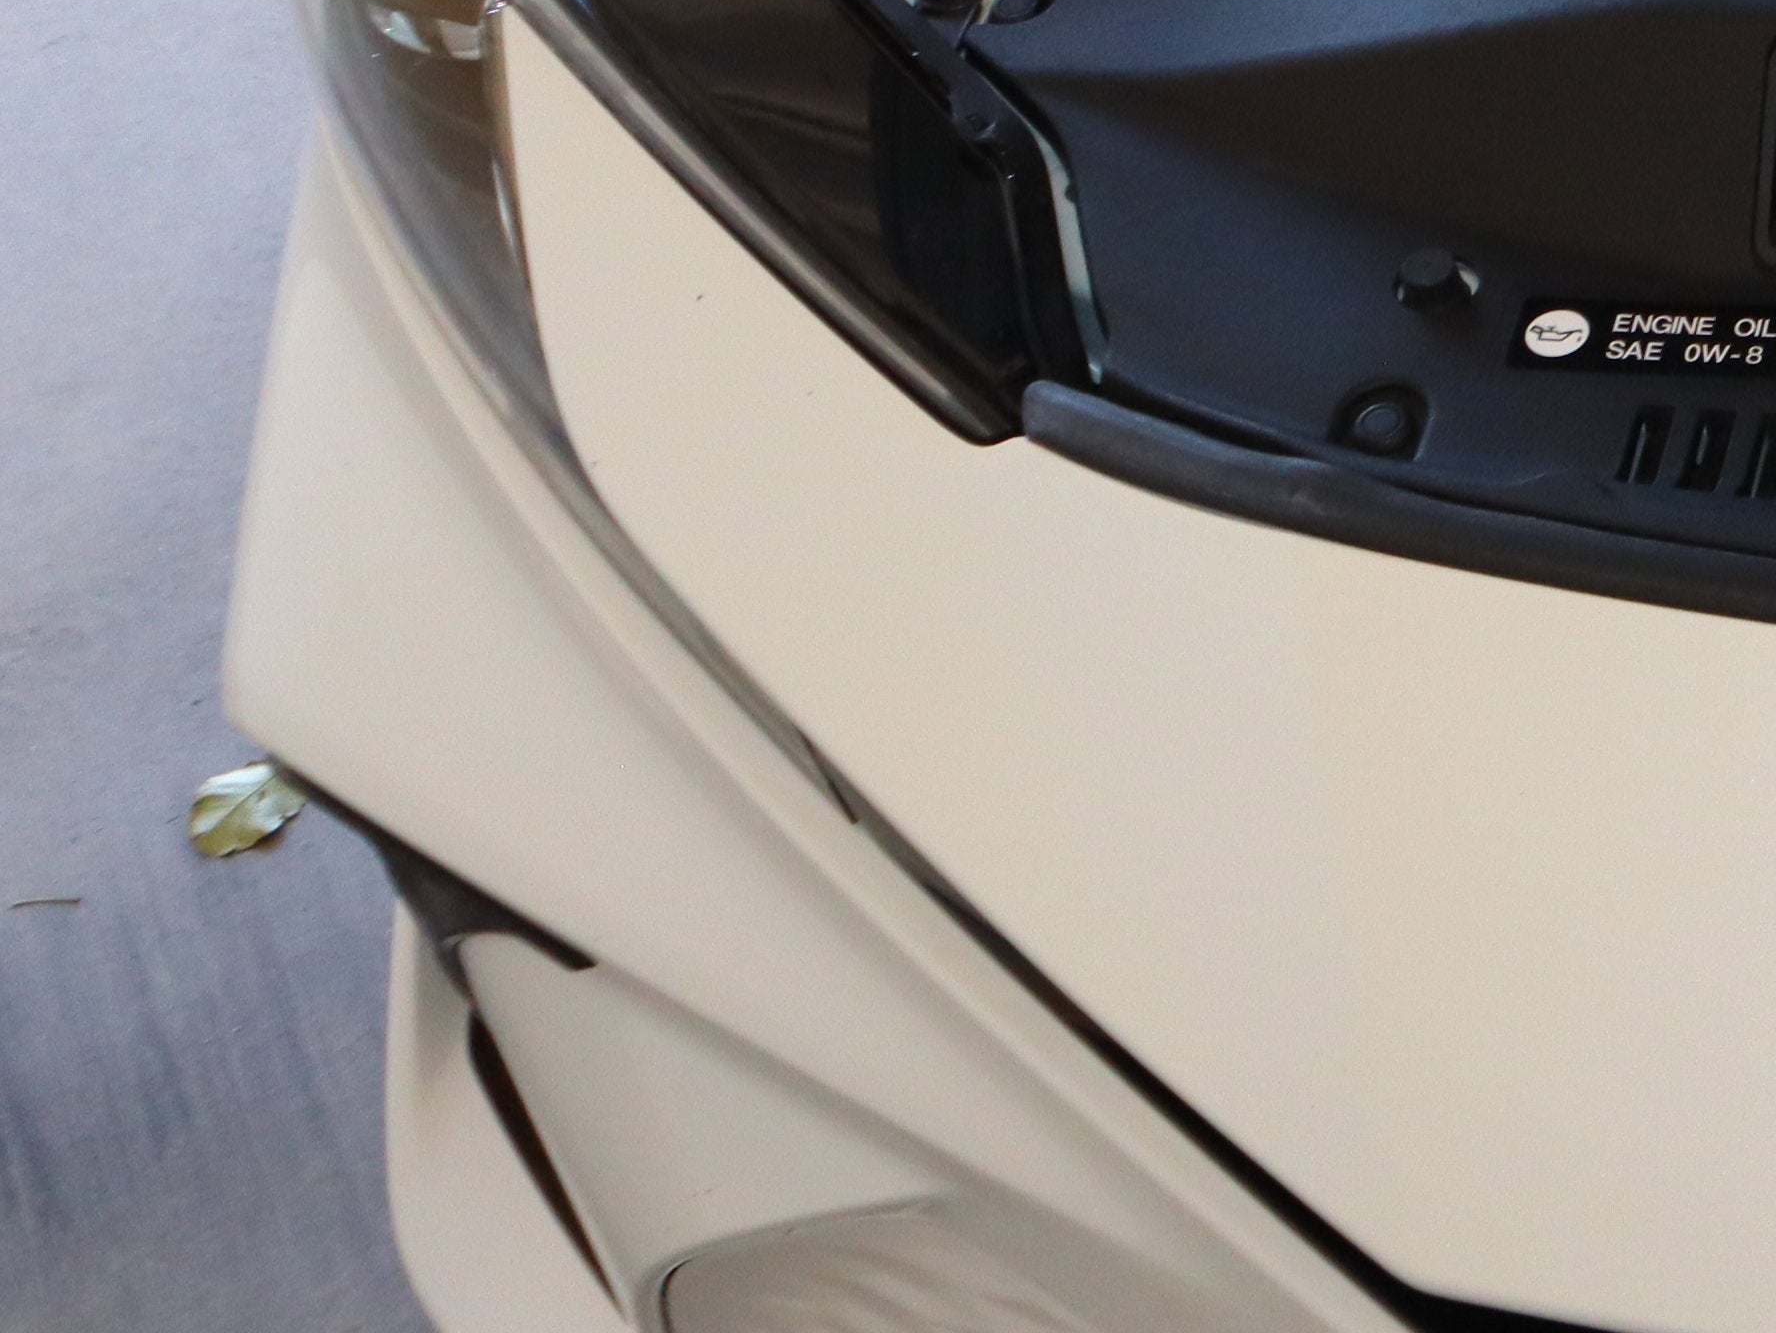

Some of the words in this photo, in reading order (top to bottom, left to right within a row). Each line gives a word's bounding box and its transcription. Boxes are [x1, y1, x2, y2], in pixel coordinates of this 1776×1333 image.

[1611, 313, 1716, 336] ENGINE
[1733, 318, 1776, 338] OIL
[1605, 340, 1665, 361] SAE
[1684, 343, 1764, 365] 0W-8
